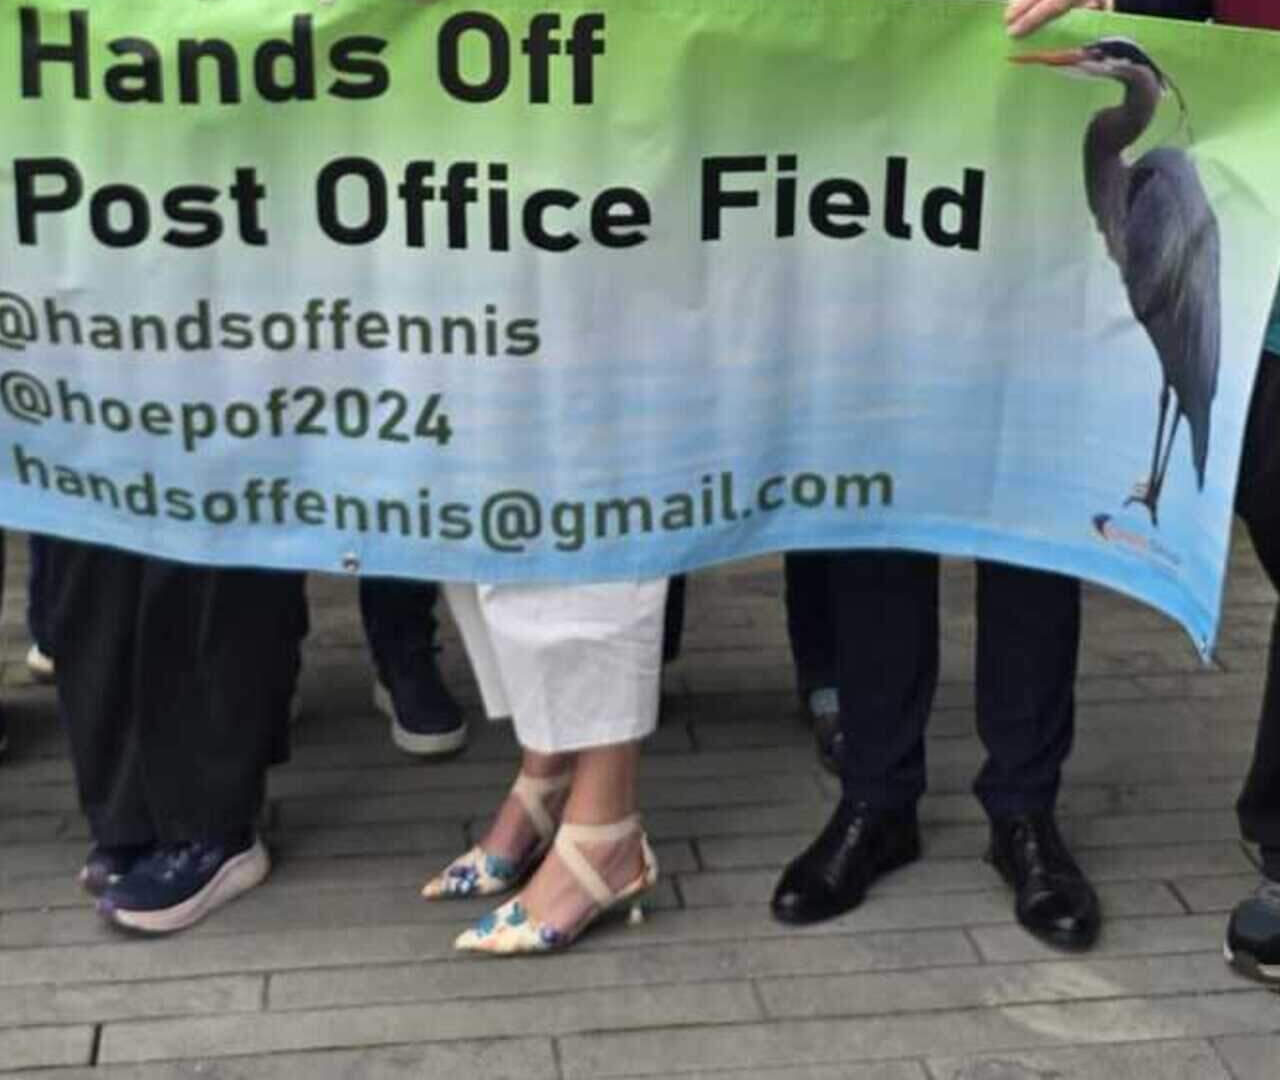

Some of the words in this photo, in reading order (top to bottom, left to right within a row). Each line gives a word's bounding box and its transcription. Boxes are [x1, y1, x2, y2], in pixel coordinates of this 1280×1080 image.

[19, 6, 390, 104] Hands
[437, 11, 606, 105] Off
[13, 156, 268, 249] Post
[316, 156, 652, 253] Office
[700, 154, 986, 252] Field
[13, 442, 895, 553] handsoffennis@gmail.com
